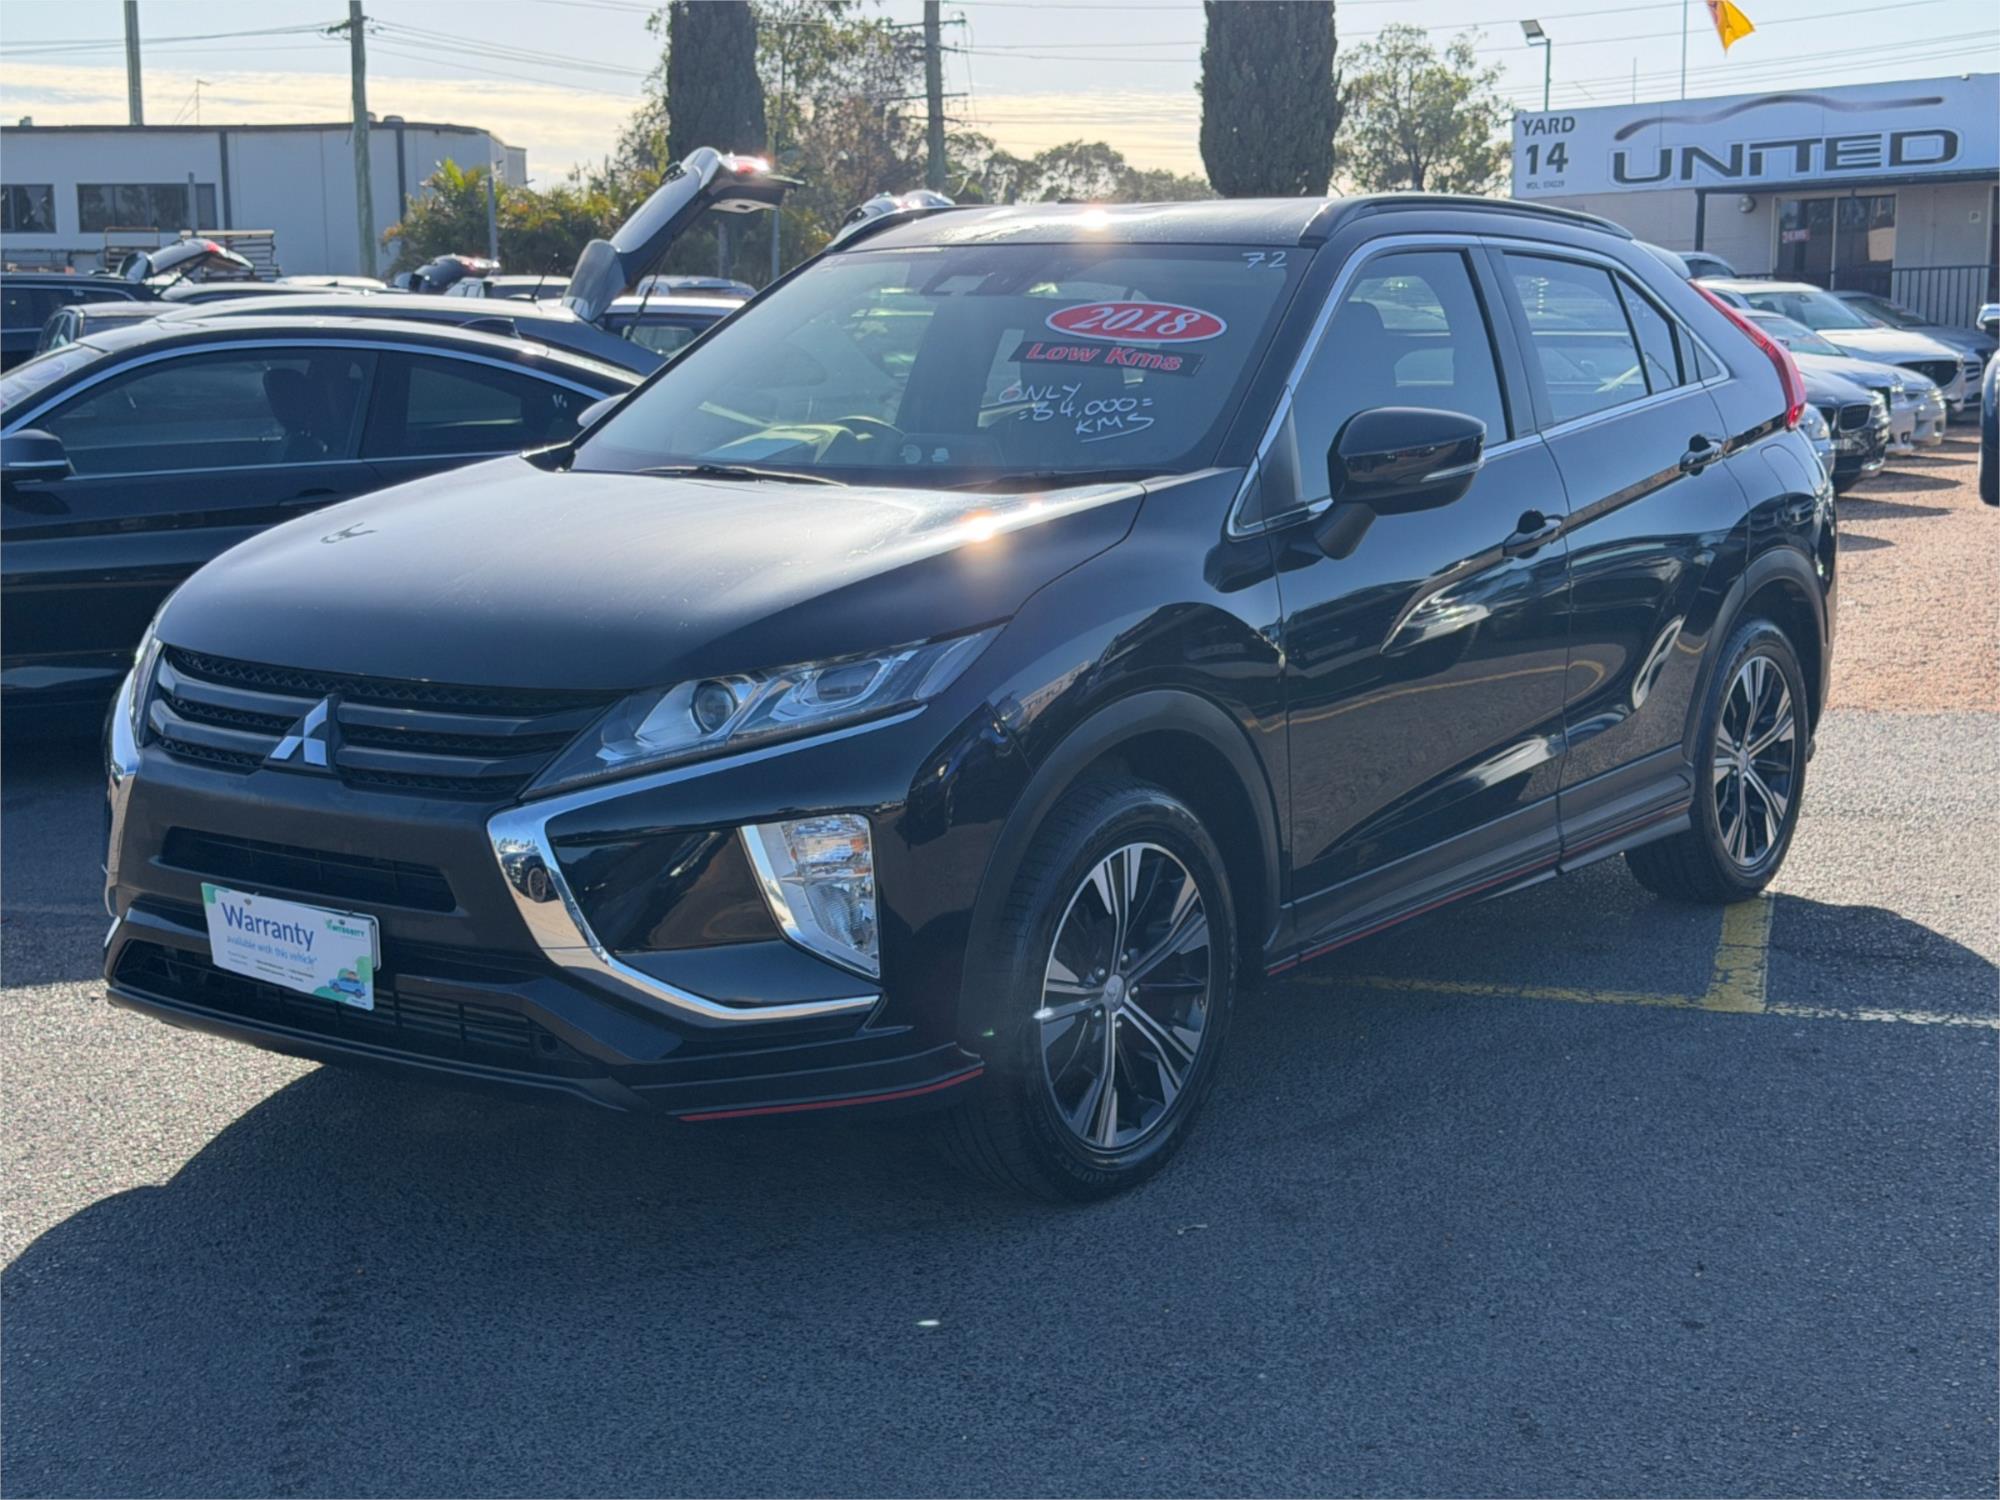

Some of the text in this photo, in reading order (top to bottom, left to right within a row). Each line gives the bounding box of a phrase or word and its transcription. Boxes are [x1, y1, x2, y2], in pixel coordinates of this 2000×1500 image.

[1522, 116, 1575, 136] YARD
[1526, 142, 1569, 175] 14
[1613, 129, 1958, 185] UNITED
[1241, 251, 1288, 269] 72
[1069, 306, 1201, 335] 2018
[1026, 343, 1184, 371] Low Kms
[999, 382, 1082, 403] ONLY
[1075, 412, 1155, 438] KMS
[221, 902, 314, 952] Warranty
